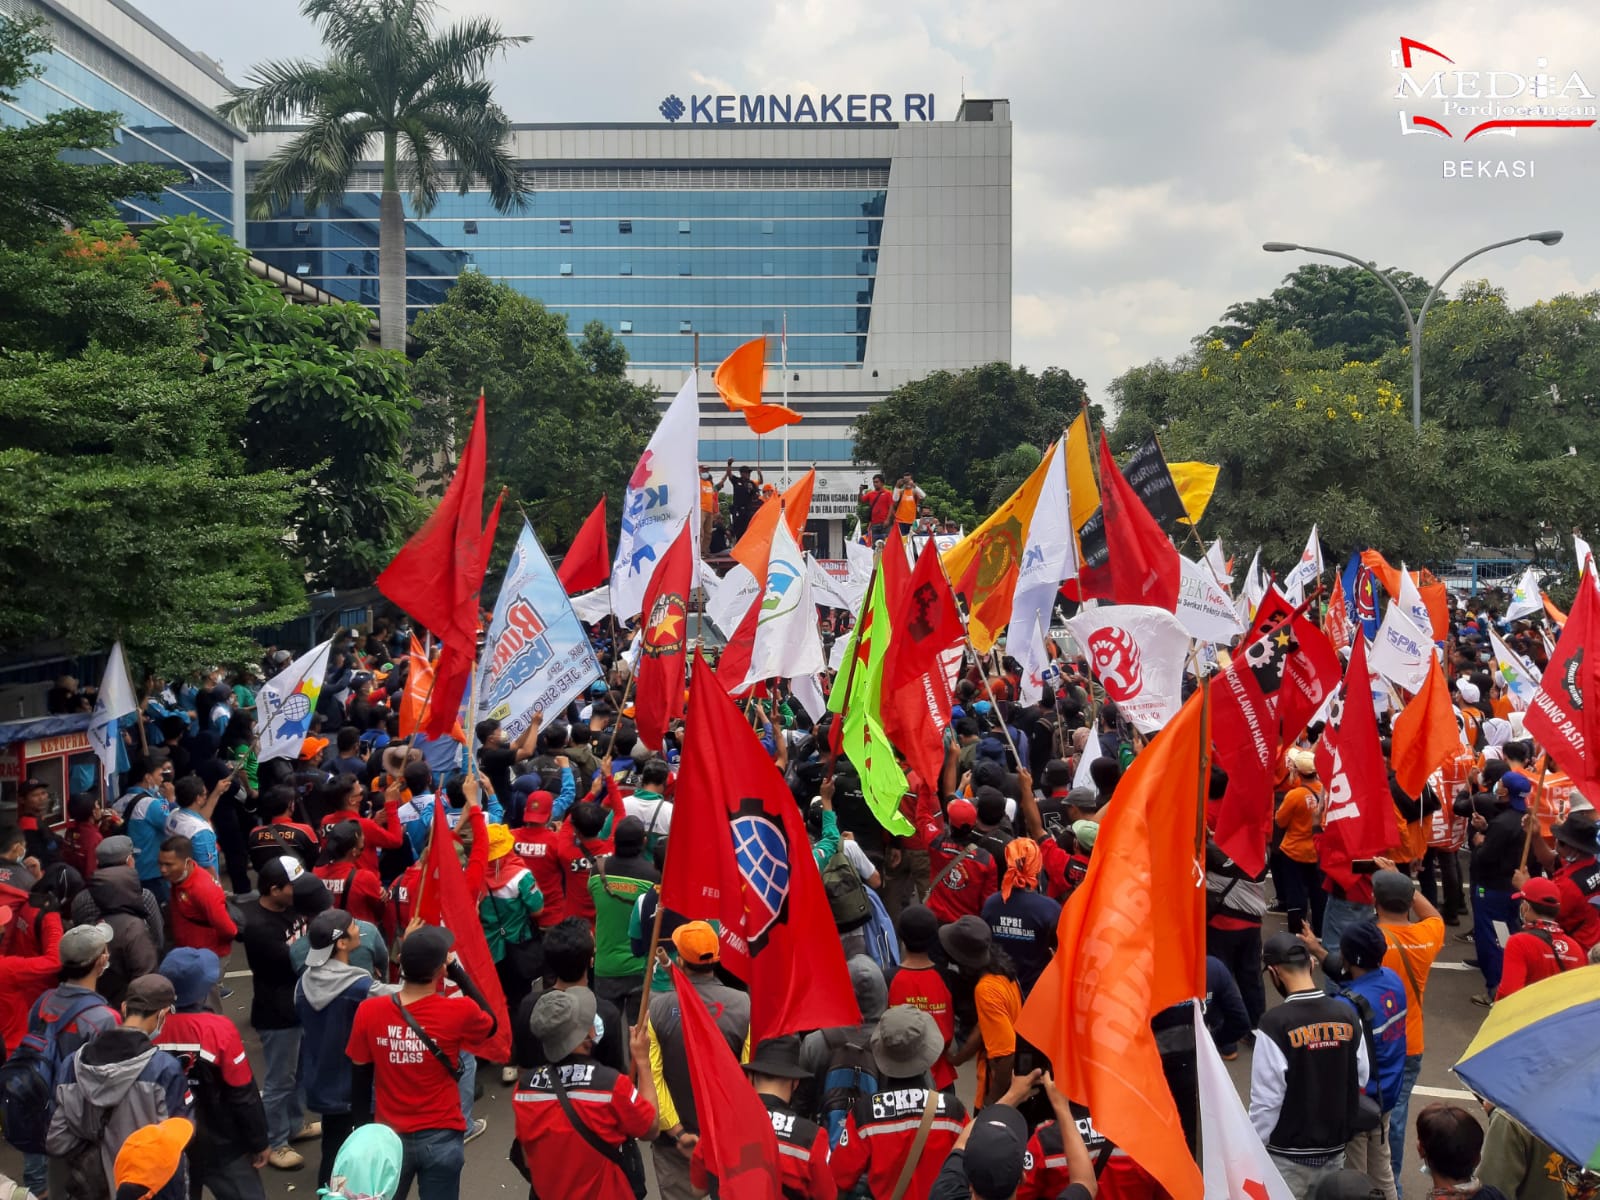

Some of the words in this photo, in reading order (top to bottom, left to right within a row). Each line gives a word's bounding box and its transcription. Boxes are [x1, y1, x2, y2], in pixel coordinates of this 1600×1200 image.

[691, 94, 892, 122] KEMNAKER
[905, 93, 934, 121] RI
[1237, 693, 1260, 729] LAWAN
[1558, 721, 1585, 749] PASTI
[1000, 916, 1022, 928] KPBI
[376, 1037, 388, 1046] THE
[388, 1025, 402, 1039] WE
[1288, 1021, 1354, 1048] UNITED
[389, 1051, 424, 1064] CLASS
[556, 1063, 595, 1084] PBI
